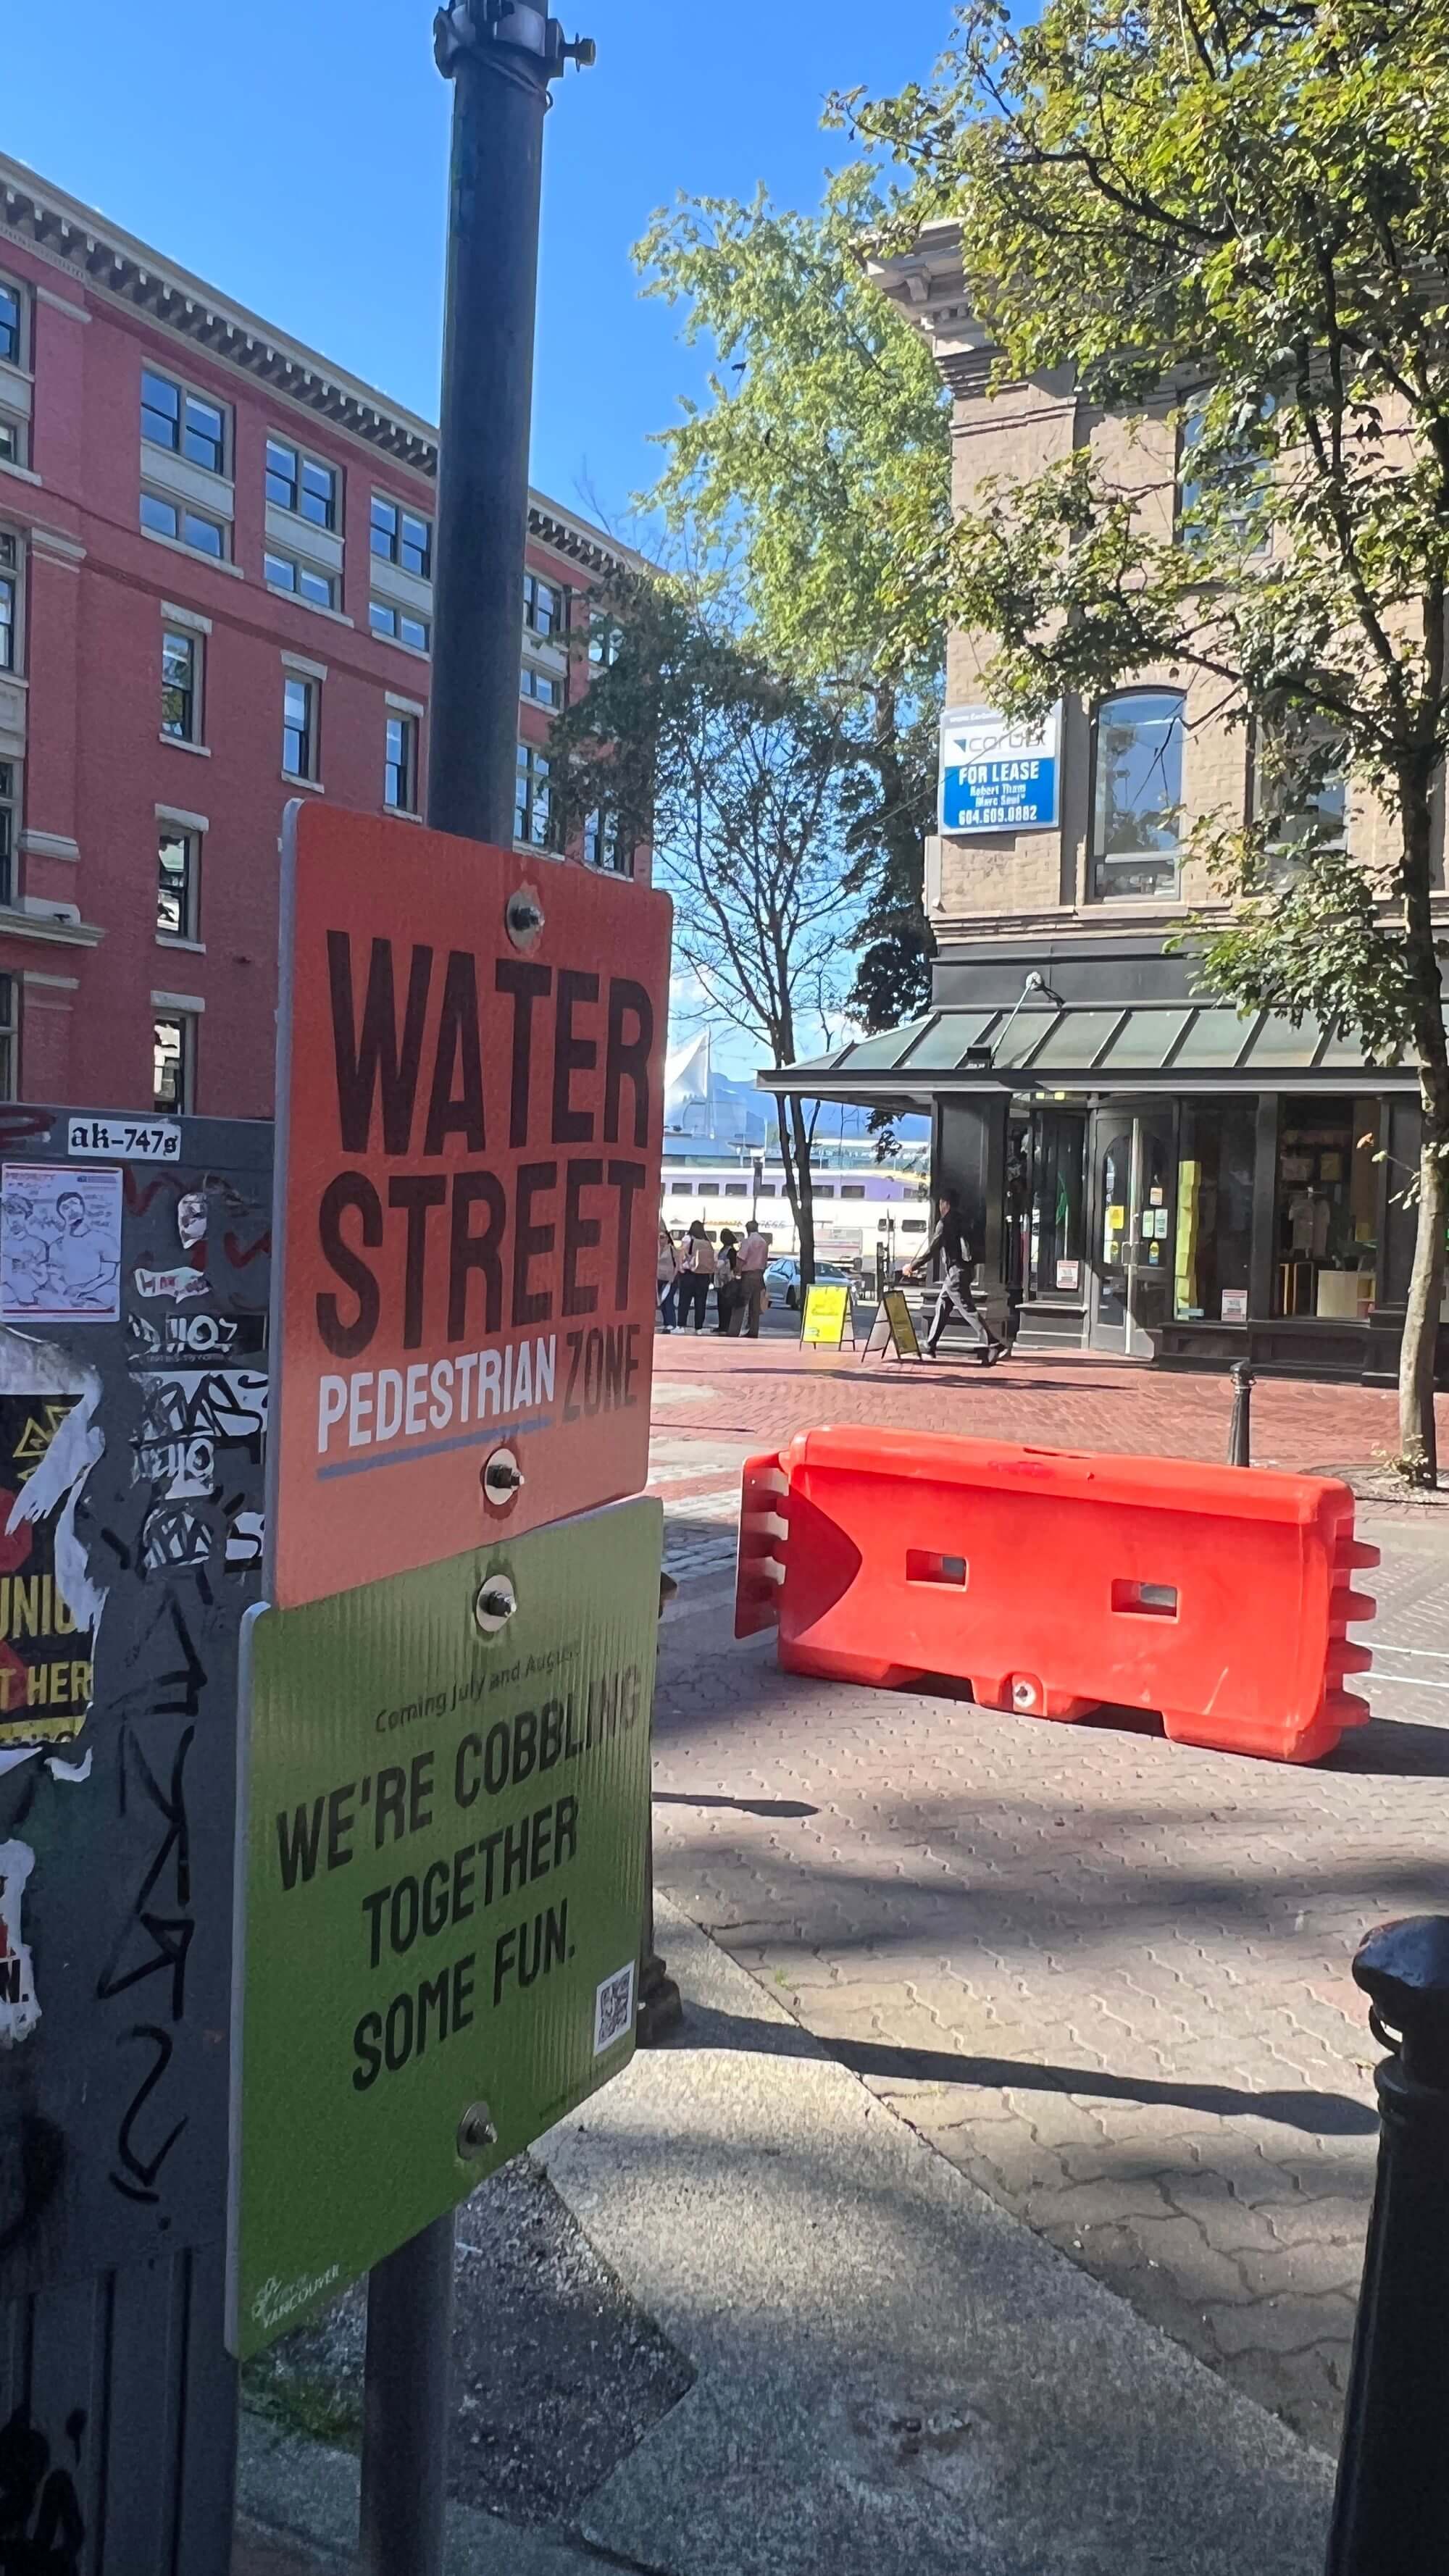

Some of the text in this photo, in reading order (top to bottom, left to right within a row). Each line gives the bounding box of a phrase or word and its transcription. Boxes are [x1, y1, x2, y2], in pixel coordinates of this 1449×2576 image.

[959, 761, 1040, 785] FOR LEASE
[969, 785, 999, 797] Robert
[326, 930, 655, 1156] WATER
[316, 1158, 646, 1360] STREET
[318, 1334, 556, 1453] PEDESTRIAN
[563, 1323, 640, 1425] ZONE
[277, 1665, 640, 1891] WE'RE COBBLING
[375, 1691, 447, 1733] Coming
[451, 1673, 486, 1711] July
[490, 1663, 520, 1692] and
[362, 1794, 578, 1970] TOGETHER
[352, 1952, 475, 2093] SOME
[493, 1898, 575, 2008] FUN.
